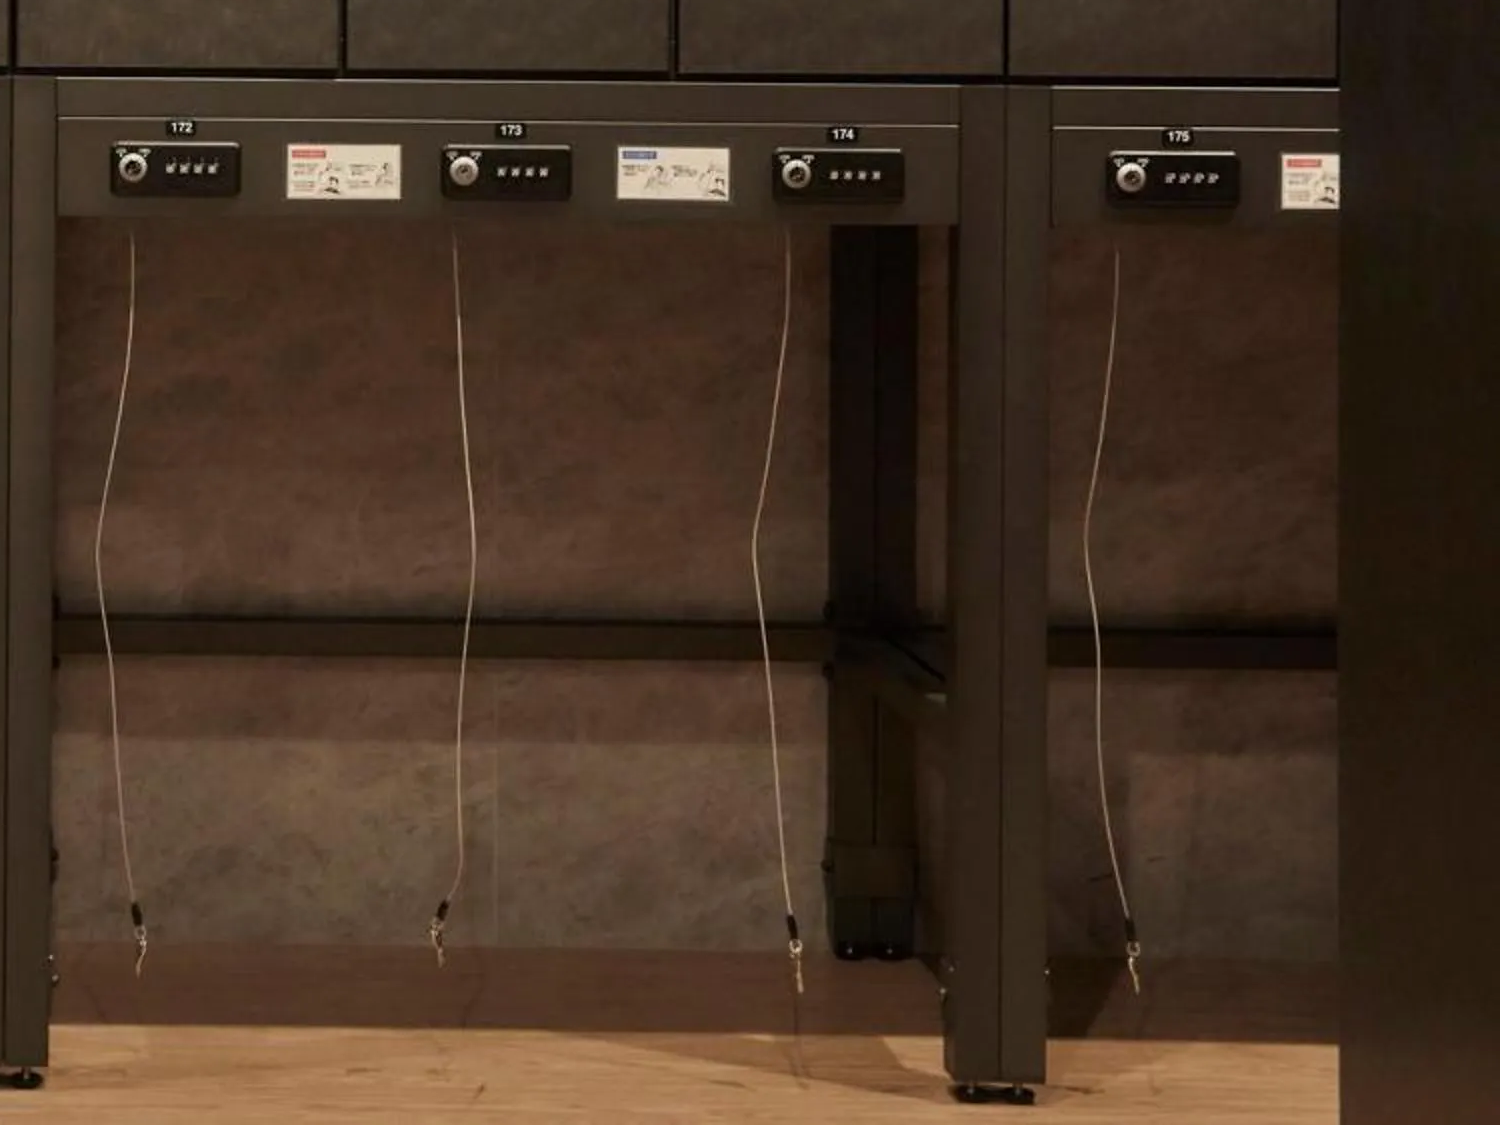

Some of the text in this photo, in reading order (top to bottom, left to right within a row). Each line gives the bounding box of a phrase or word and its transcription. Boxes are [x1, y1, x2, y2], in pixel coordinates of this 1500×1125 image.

[171, 121, 193, 133] 172
[500, 124, 523, 136] 173
[832, 128, 854, 140] 174
[1168, 130, 1190, 142] 175
